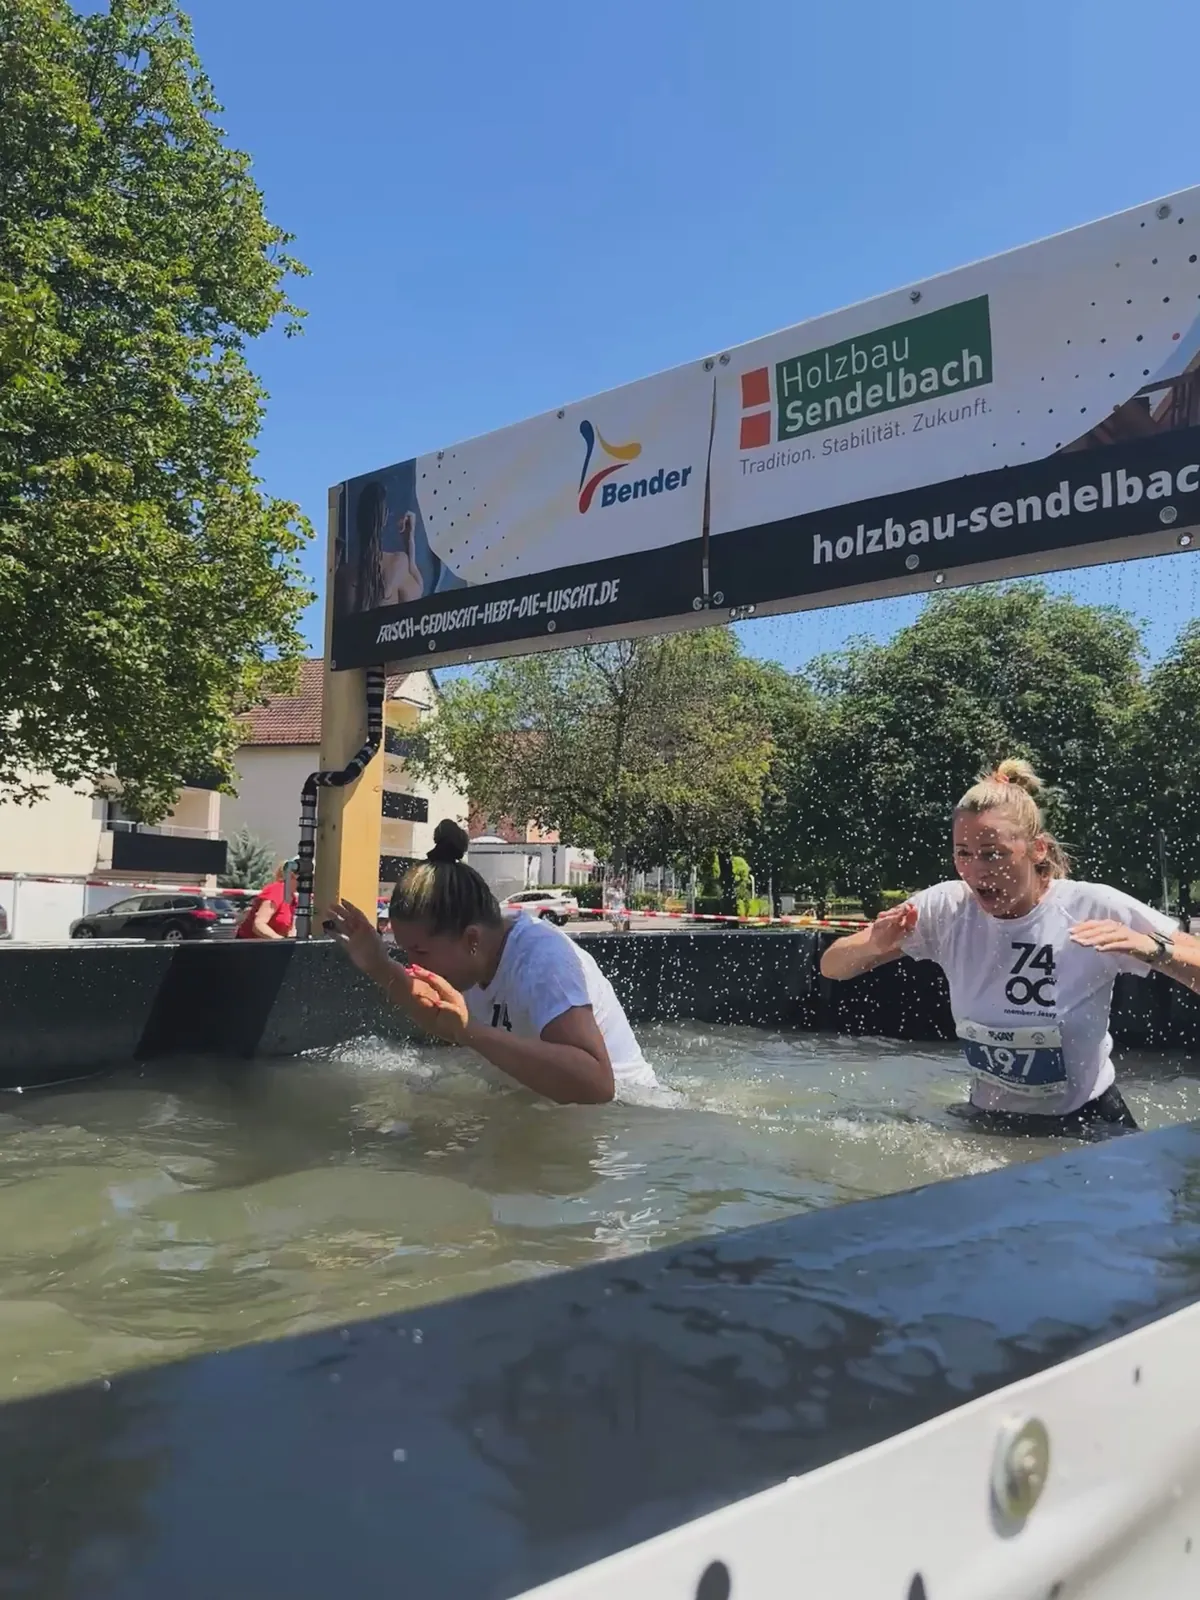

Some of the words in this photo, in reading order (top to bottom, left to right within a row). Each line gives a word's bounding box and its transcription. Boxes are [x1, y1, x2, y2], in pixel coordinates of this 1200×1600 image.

[782, 336, 910, 397] Holzbau
[784, 348, 984, 433] Sendelbach
[739, 448, 816, 476] Tradition.
[822, 421, 906, 456] Stabilität.
[912, 397, 992, 433] Zukunft.
[600, 465, 692, 508] Bender
[375, 578, 621, 644] FRISCH-GEDUSCHT-HEBT-DIE-LUSCHT.DE
[1009, 941, 1056, 976] 74
[1005, 975, 1057, 1007] OC
[979, 1045, 1037, 1077] 197
